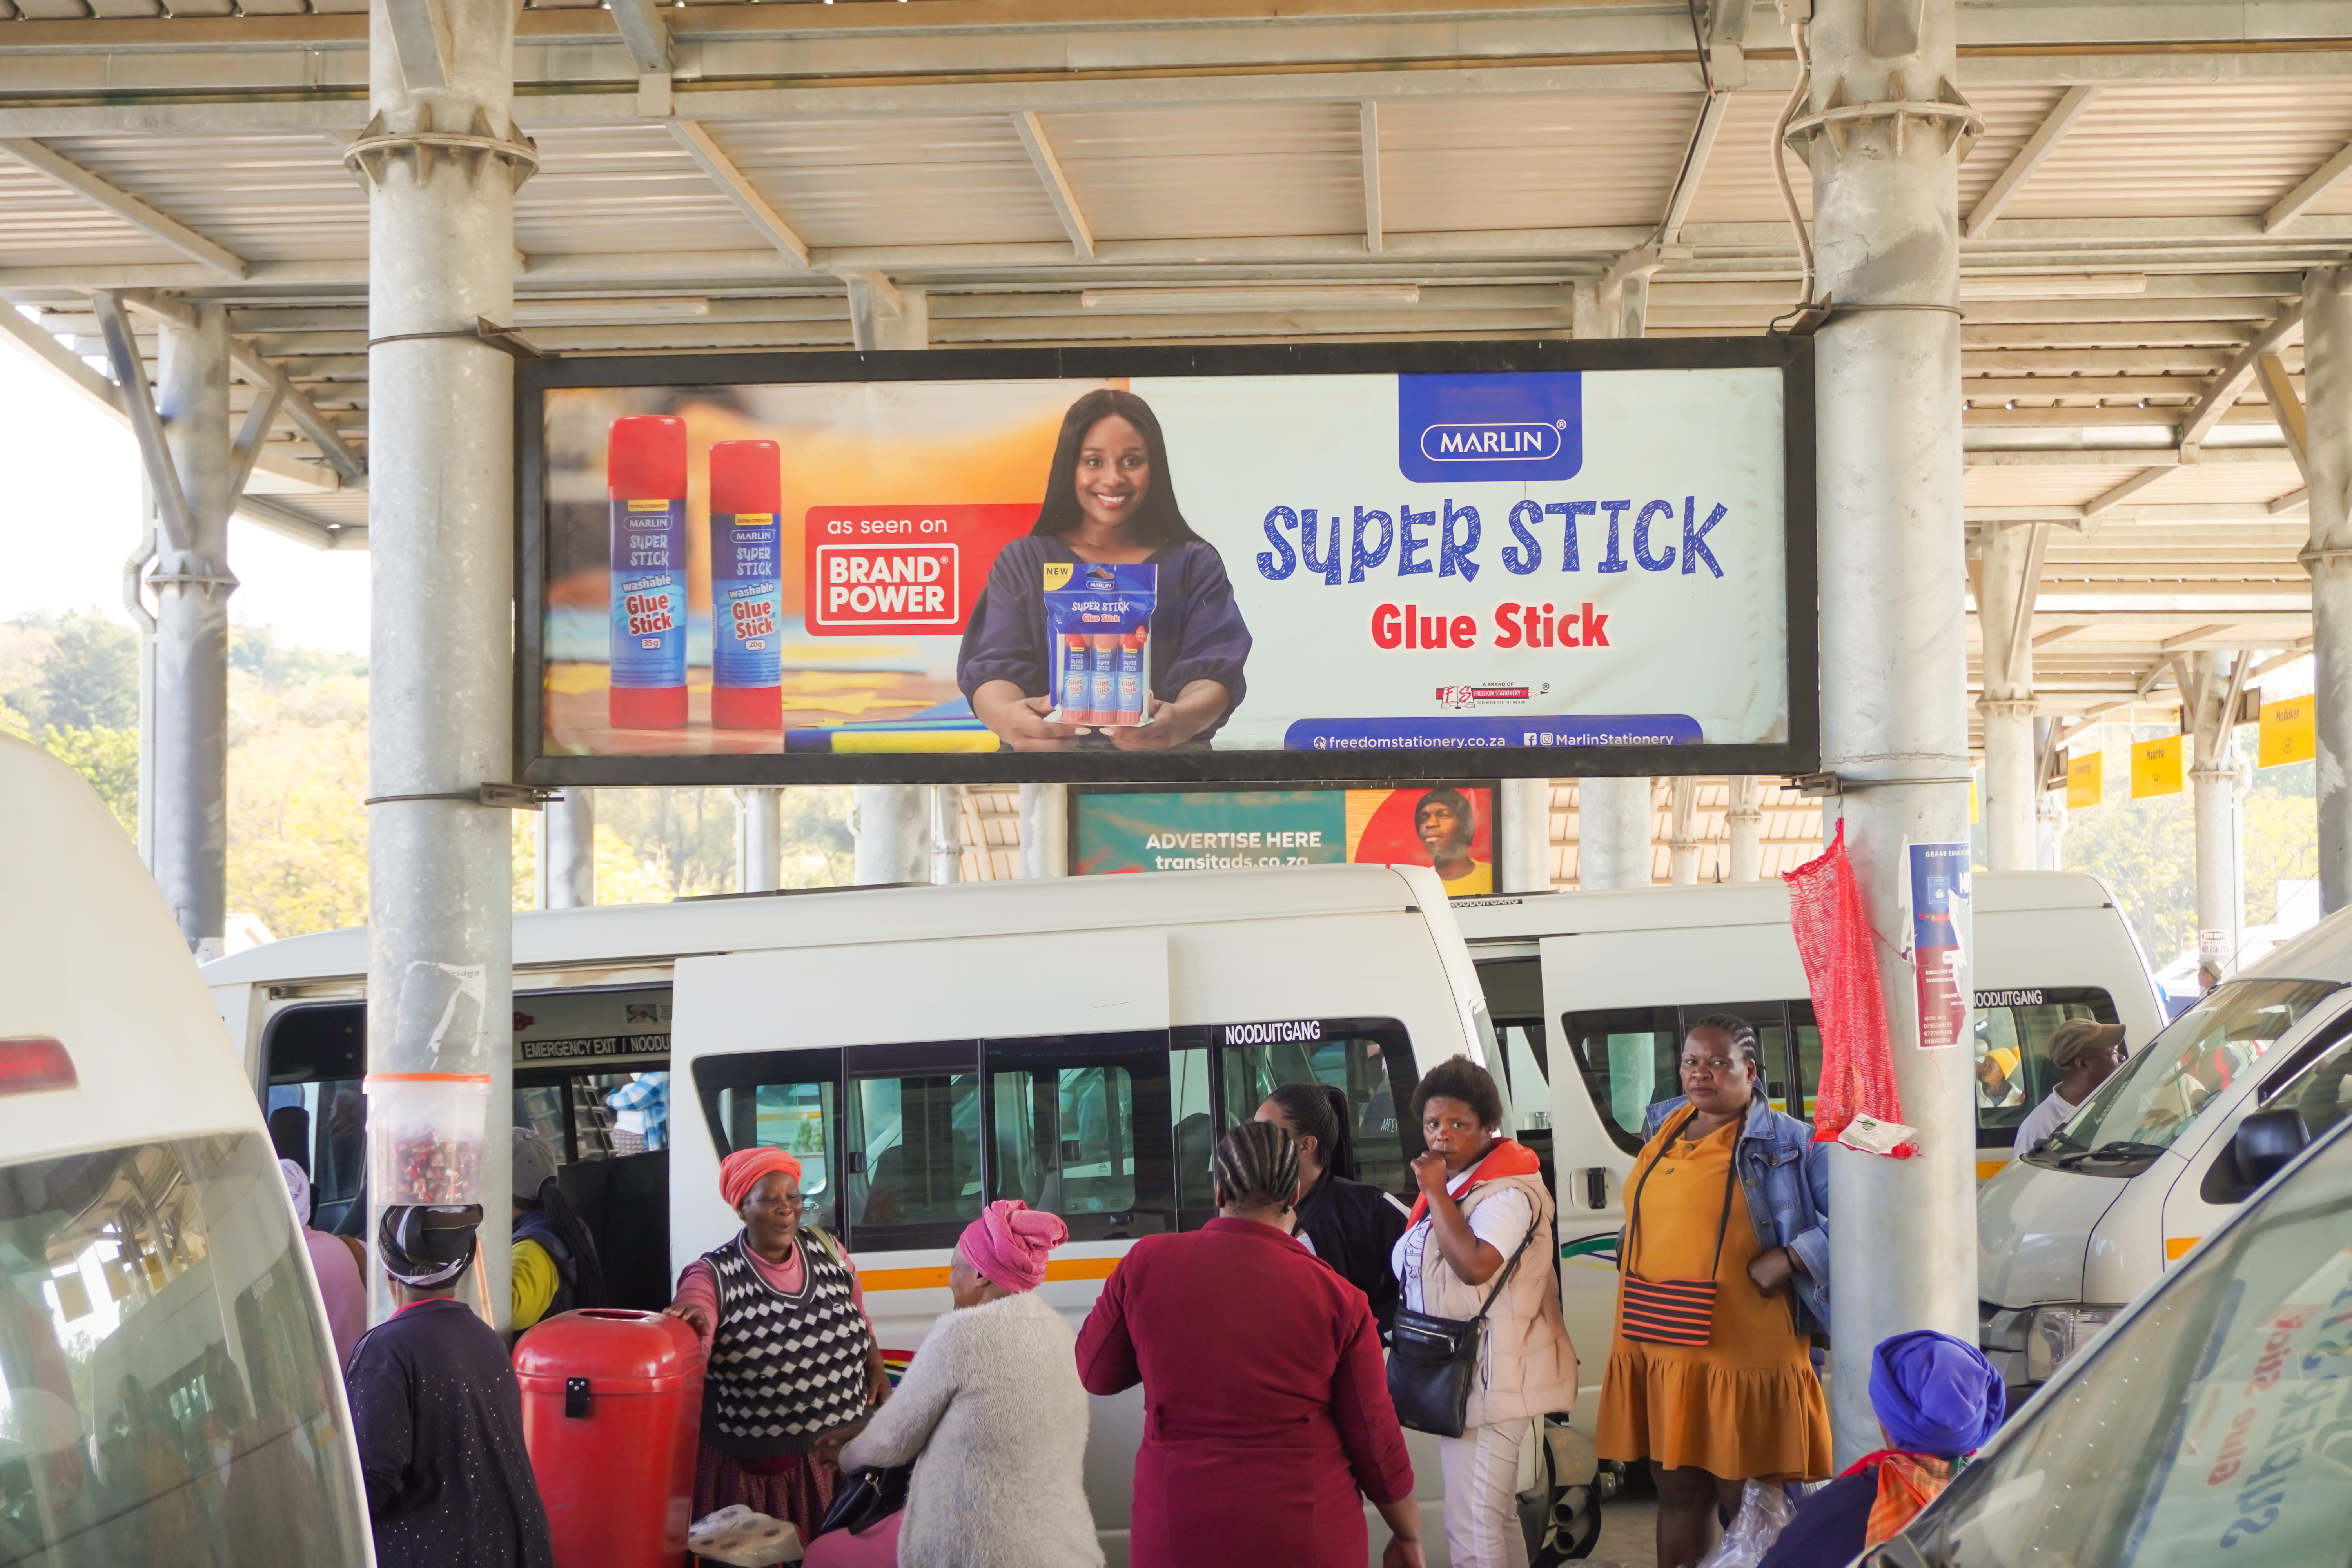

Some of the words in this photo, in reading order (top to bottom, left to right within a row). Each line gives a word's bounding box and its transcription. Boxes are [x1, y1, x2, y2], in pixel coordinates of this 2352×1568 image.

[1440, 431, 1542, 453] MARLIN
[827, 521, 853, 534] as
[860, 520, 911, 534] seen
[920, 519, 947, 533] on
[630, 534, 668, 549] SUPER
[1256, 498, 1481, 586] SUPER
[1502, 496, 1728, 578] STICK
[630, 551, 670, 566] STICK
[736, 546, 771, 561] SUPER
[737, 562, 772, 575] STICK
[830, 556, 940, 583] BRAND
[622, 575, 671, 592] washable
[729, 583, 773, 598] washable
[626, 595, 668, 615] Glue
[830, 586, 945, 613] POWER
[1072, 601, 1099, 612] SUPER
[1102, 601, 1130, 612] STICK
[732, 601, 771, 620] Glue
[630, 612, 672, 635] Stick
[736, 618, 773, 639] Stick
[1372, 604, 1476, 649] Glue
[1494, 602, 1610, 648] Stick
[2276, 706, 2299, 723] Madaken
[1329, 736, 1505, 748] freedomstationery.co.za
[1557, 734, 1673, 745] MarlinStationery
[2147, 746, 2164, 760] Mzantsi
[1145, 832, 1261, 849] ADVERTISE
[1267, 832, 1321, 848] HERE
[1156, 853, 1308, 869] transitads.co.za
[1225, 1020, 1320, 1045] NOODUITGANG
[525, 1039, 591, 1058] EMERGENCY
[594, 1038, 617, 1054] EXIT
